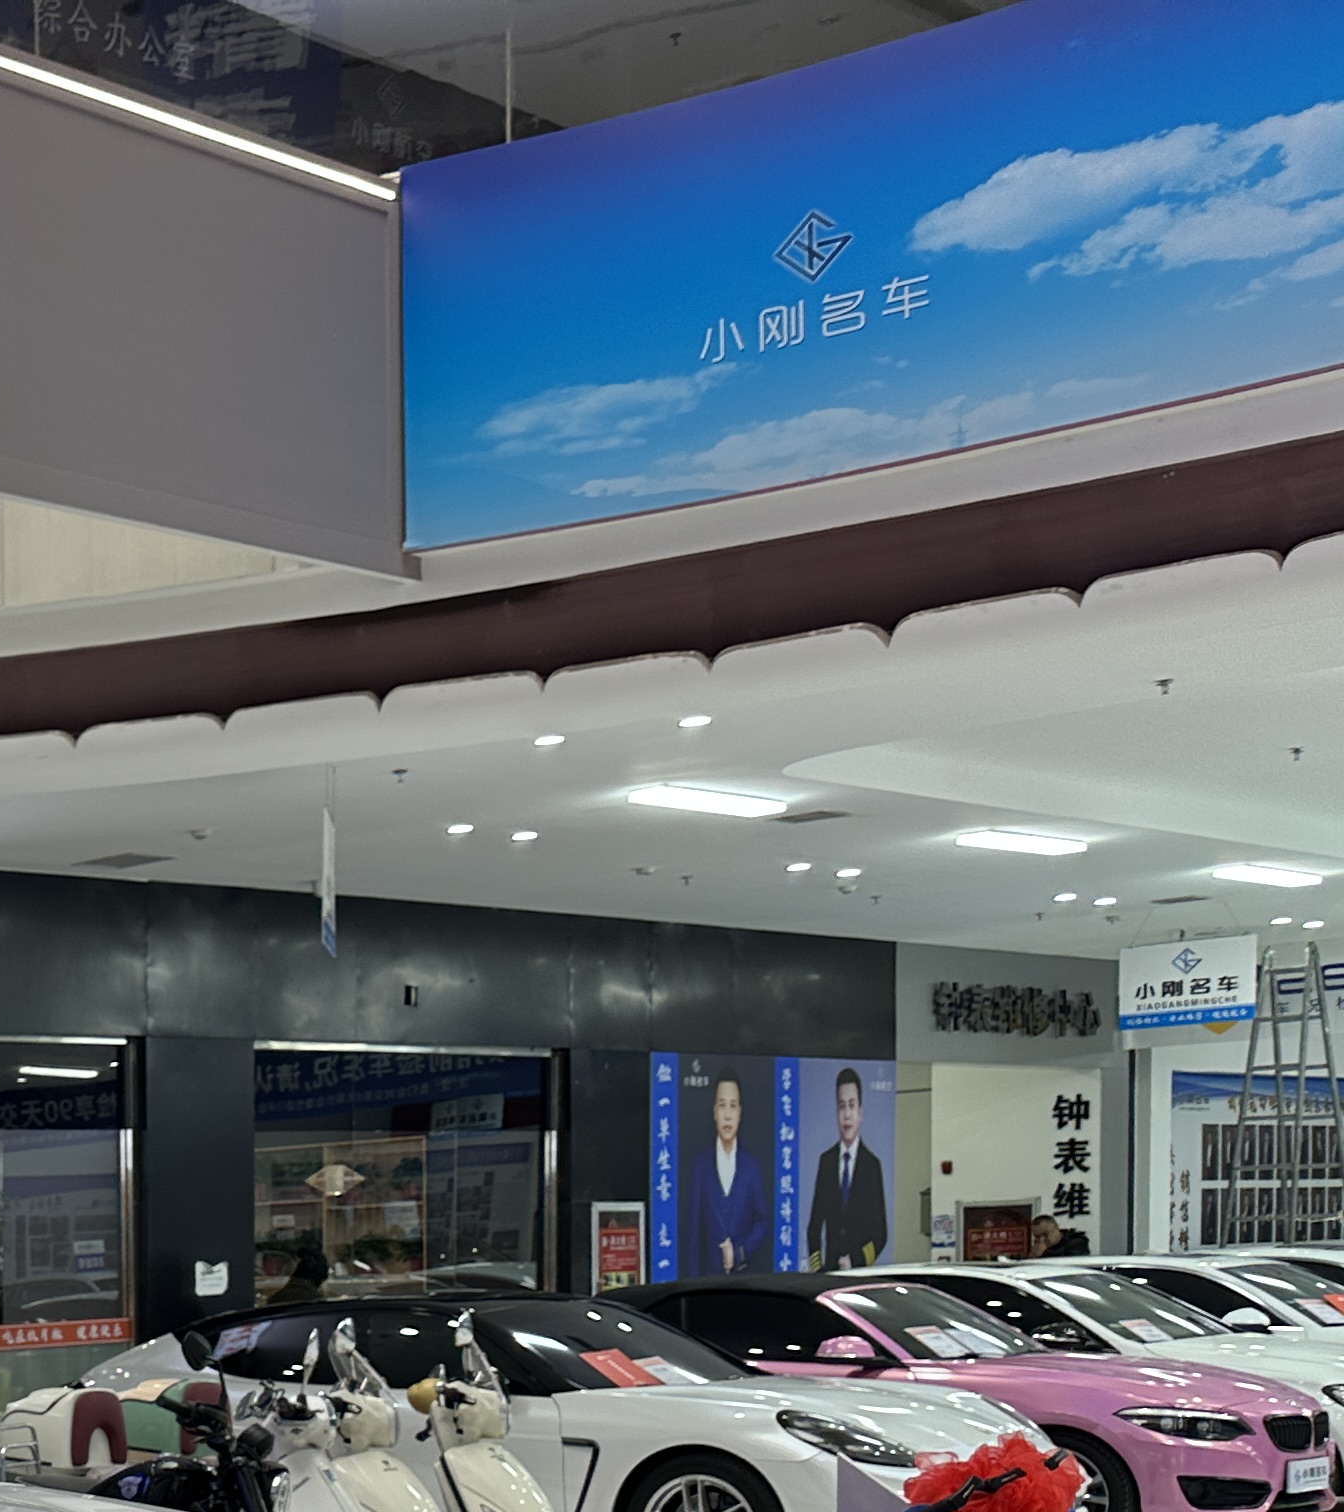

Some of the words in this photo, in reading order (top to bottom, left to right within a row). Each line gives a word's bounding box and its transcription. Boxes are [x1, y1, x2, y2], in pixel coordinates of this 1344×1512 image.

[699, 275, 930, 364] 小刚名车
[1135, 975, 1239, 1000] 小刚名车
[1052, 1094, 1091, 1240] 钟表维
